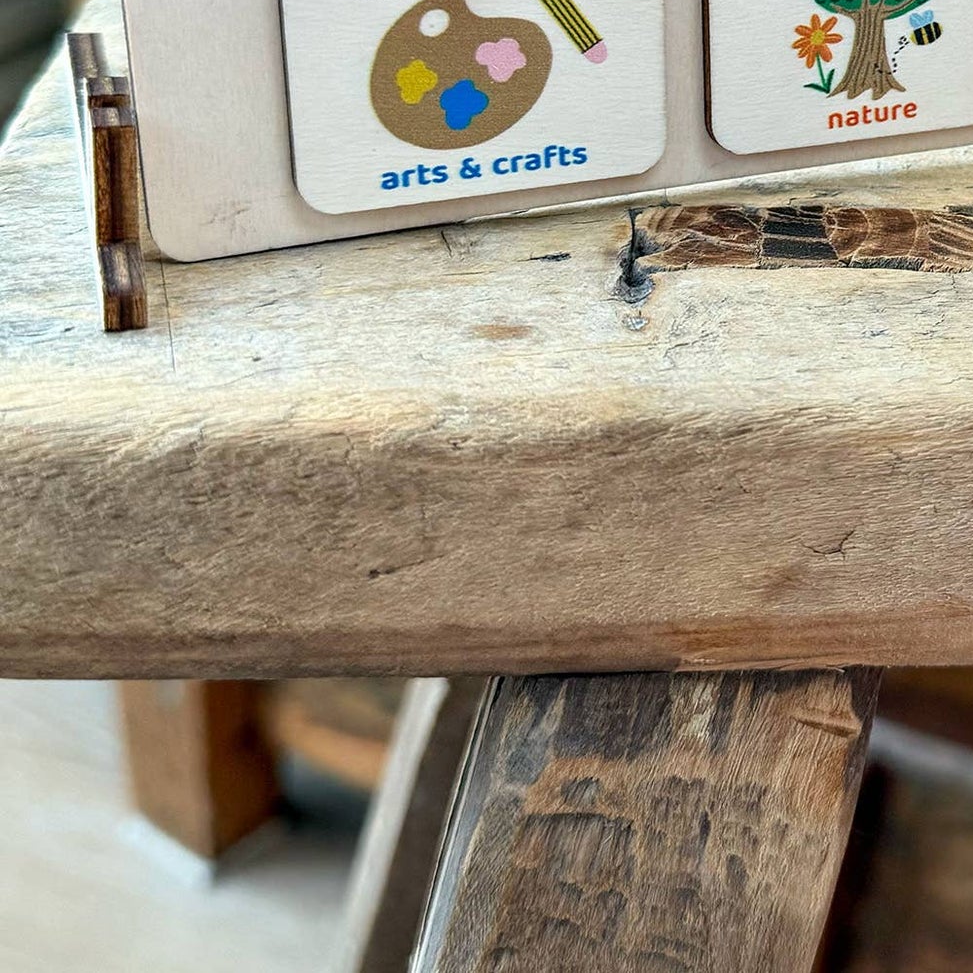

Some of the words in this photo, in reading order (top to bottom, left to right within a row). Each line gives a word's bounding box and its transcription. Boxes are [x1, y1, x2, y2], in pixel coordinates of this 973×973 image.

[828, 102, 918, 129] nature
[381, 164, 449, 191] arts
[459, 157, 482, 179] &
[492, 145, 588, 176] crafts
